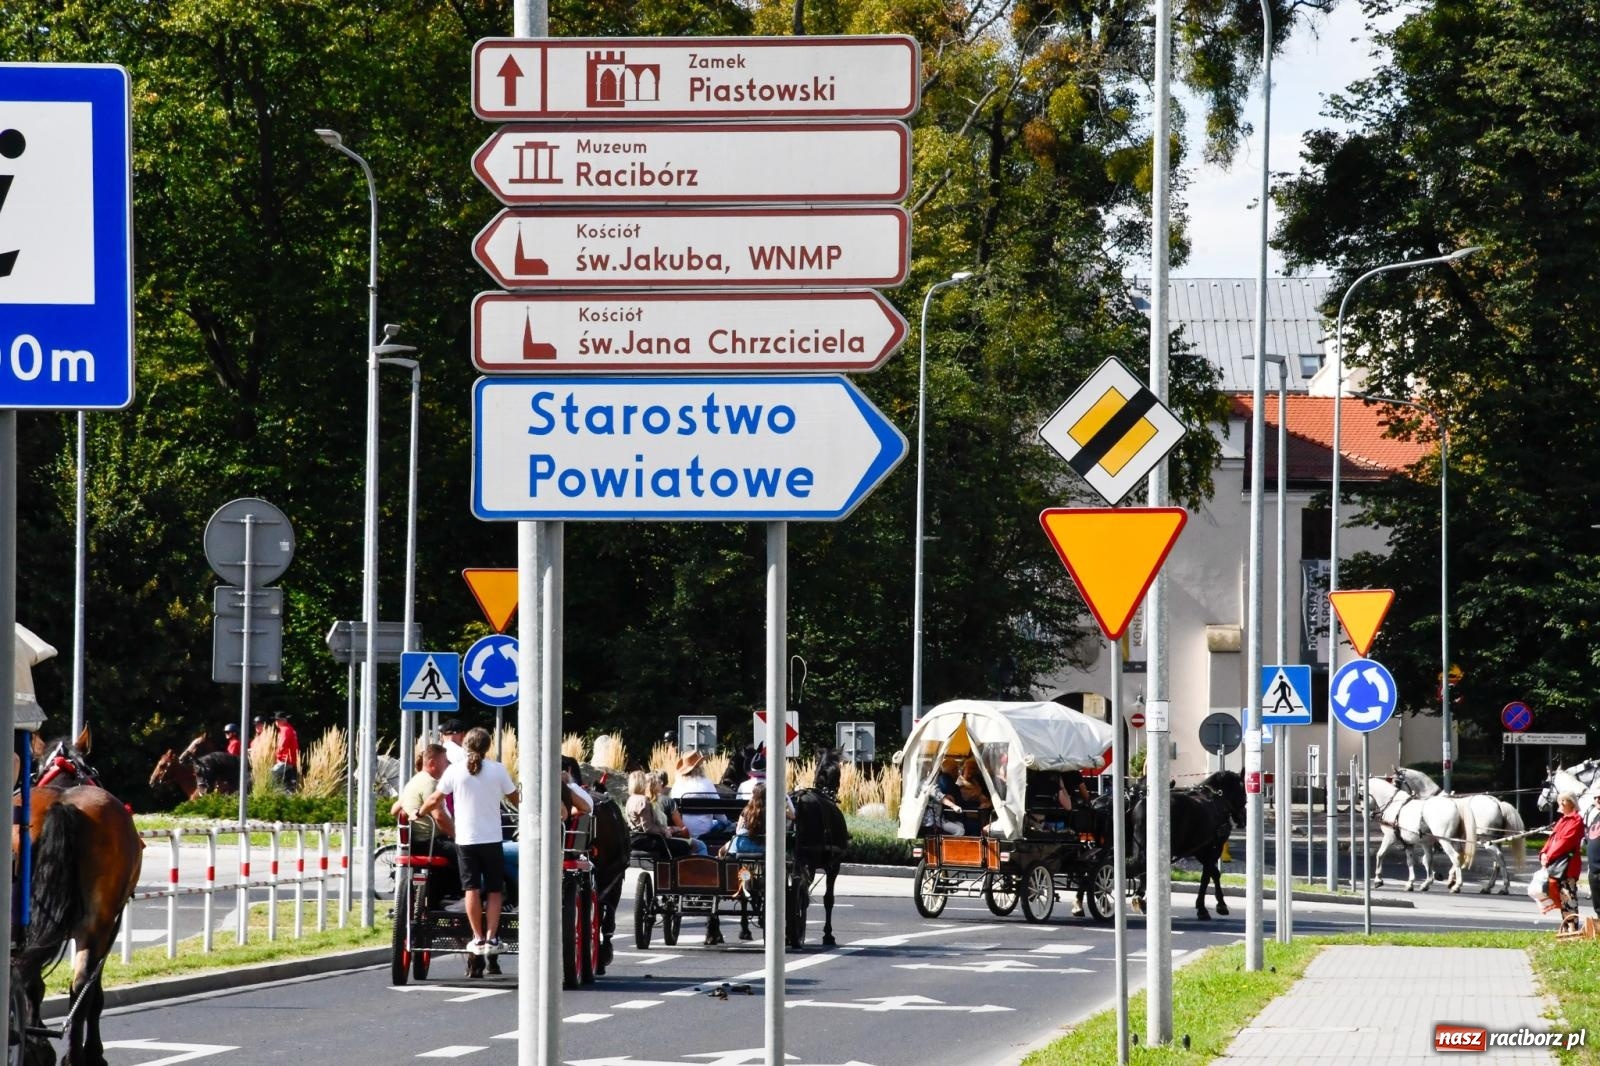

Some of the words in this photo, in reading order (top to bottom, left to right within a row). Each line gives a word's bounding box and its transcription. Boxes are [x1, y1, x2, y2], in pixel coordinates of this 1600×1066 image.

[688, 53, 746, 69] Zamek
[689, 75, 835, 103] Piastowski
[576, 138, 647, 154] Muzeum
[576, 161, 699, 187] Racibórz
[576, 223, 641, 239] Kościół
[748, 245, 842, 271] WNMP
[578, 307, 643, 323] Kościół
[578, 329, 691, 356] św.Jana
[708, 328, 865, 355] Chrzciciela
[0, 333, 96, 382] 0m
[527, 390, 797, 437] Starostwo
[529, 453, 814, 499] Powiatowe
